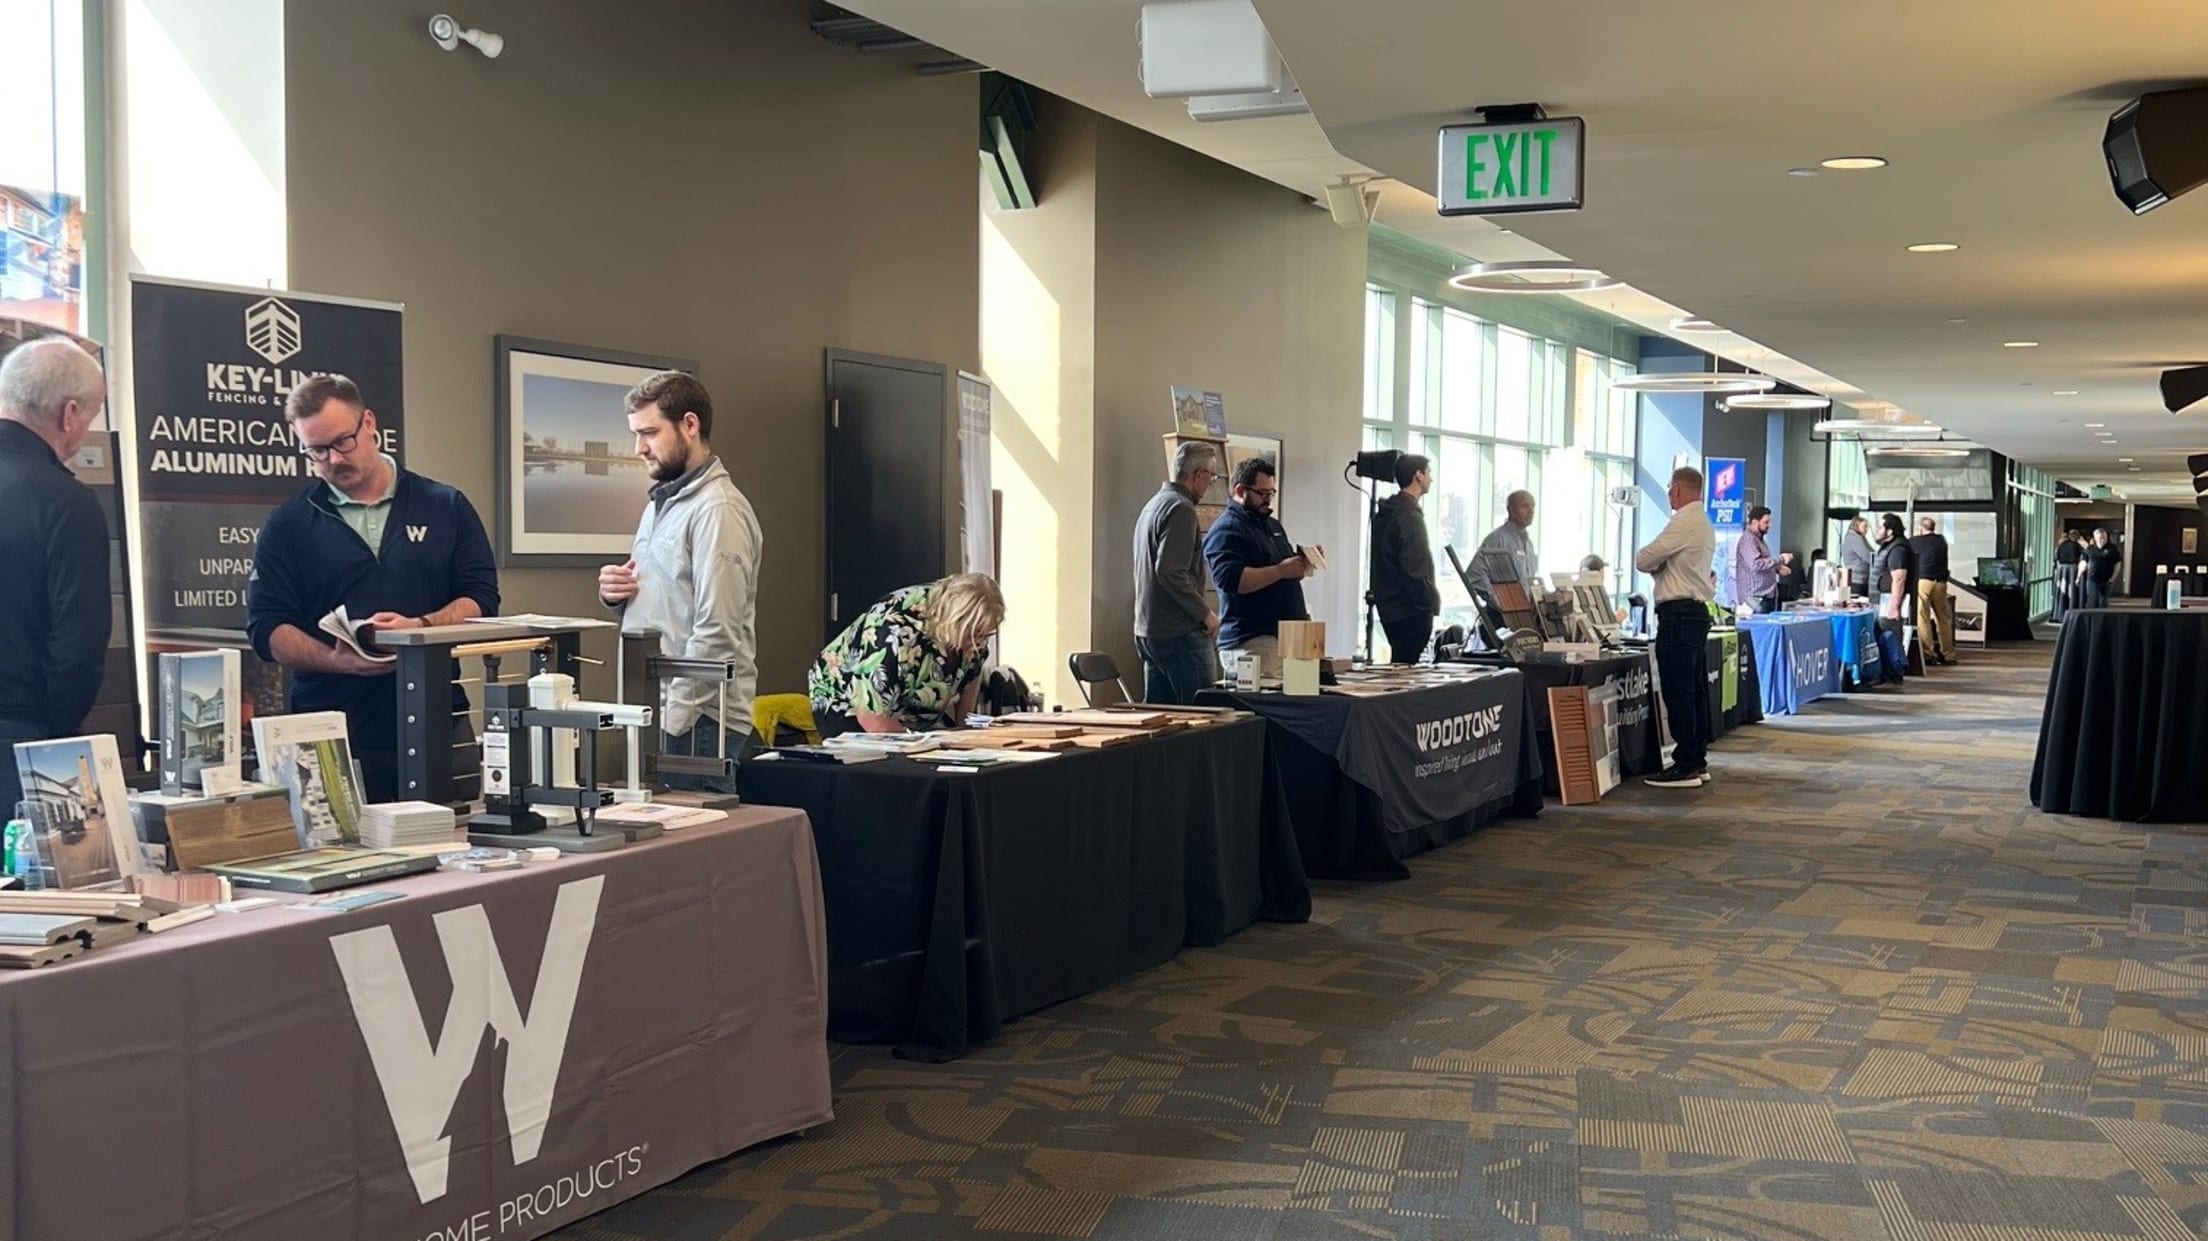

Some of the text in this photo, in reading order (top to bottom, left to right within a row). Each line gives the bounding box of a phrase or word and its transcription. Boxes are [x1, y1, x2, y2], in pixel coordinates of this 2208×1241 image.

[1466, 130, 1558, 200] EXIT
[208, 391, 282, 407] FENCING &
[151, 450, 297, 477] ALUMINUM
[219, 527, 260, 544] EASY
[406, 525, 427, 543] W
[174, 590, 237, 607] LIMITED
[1796, 647, 1829, 689] HOVER
[1416, 704, 1503, 752] WOODTONE
[329, 875, 605, 1204] W
